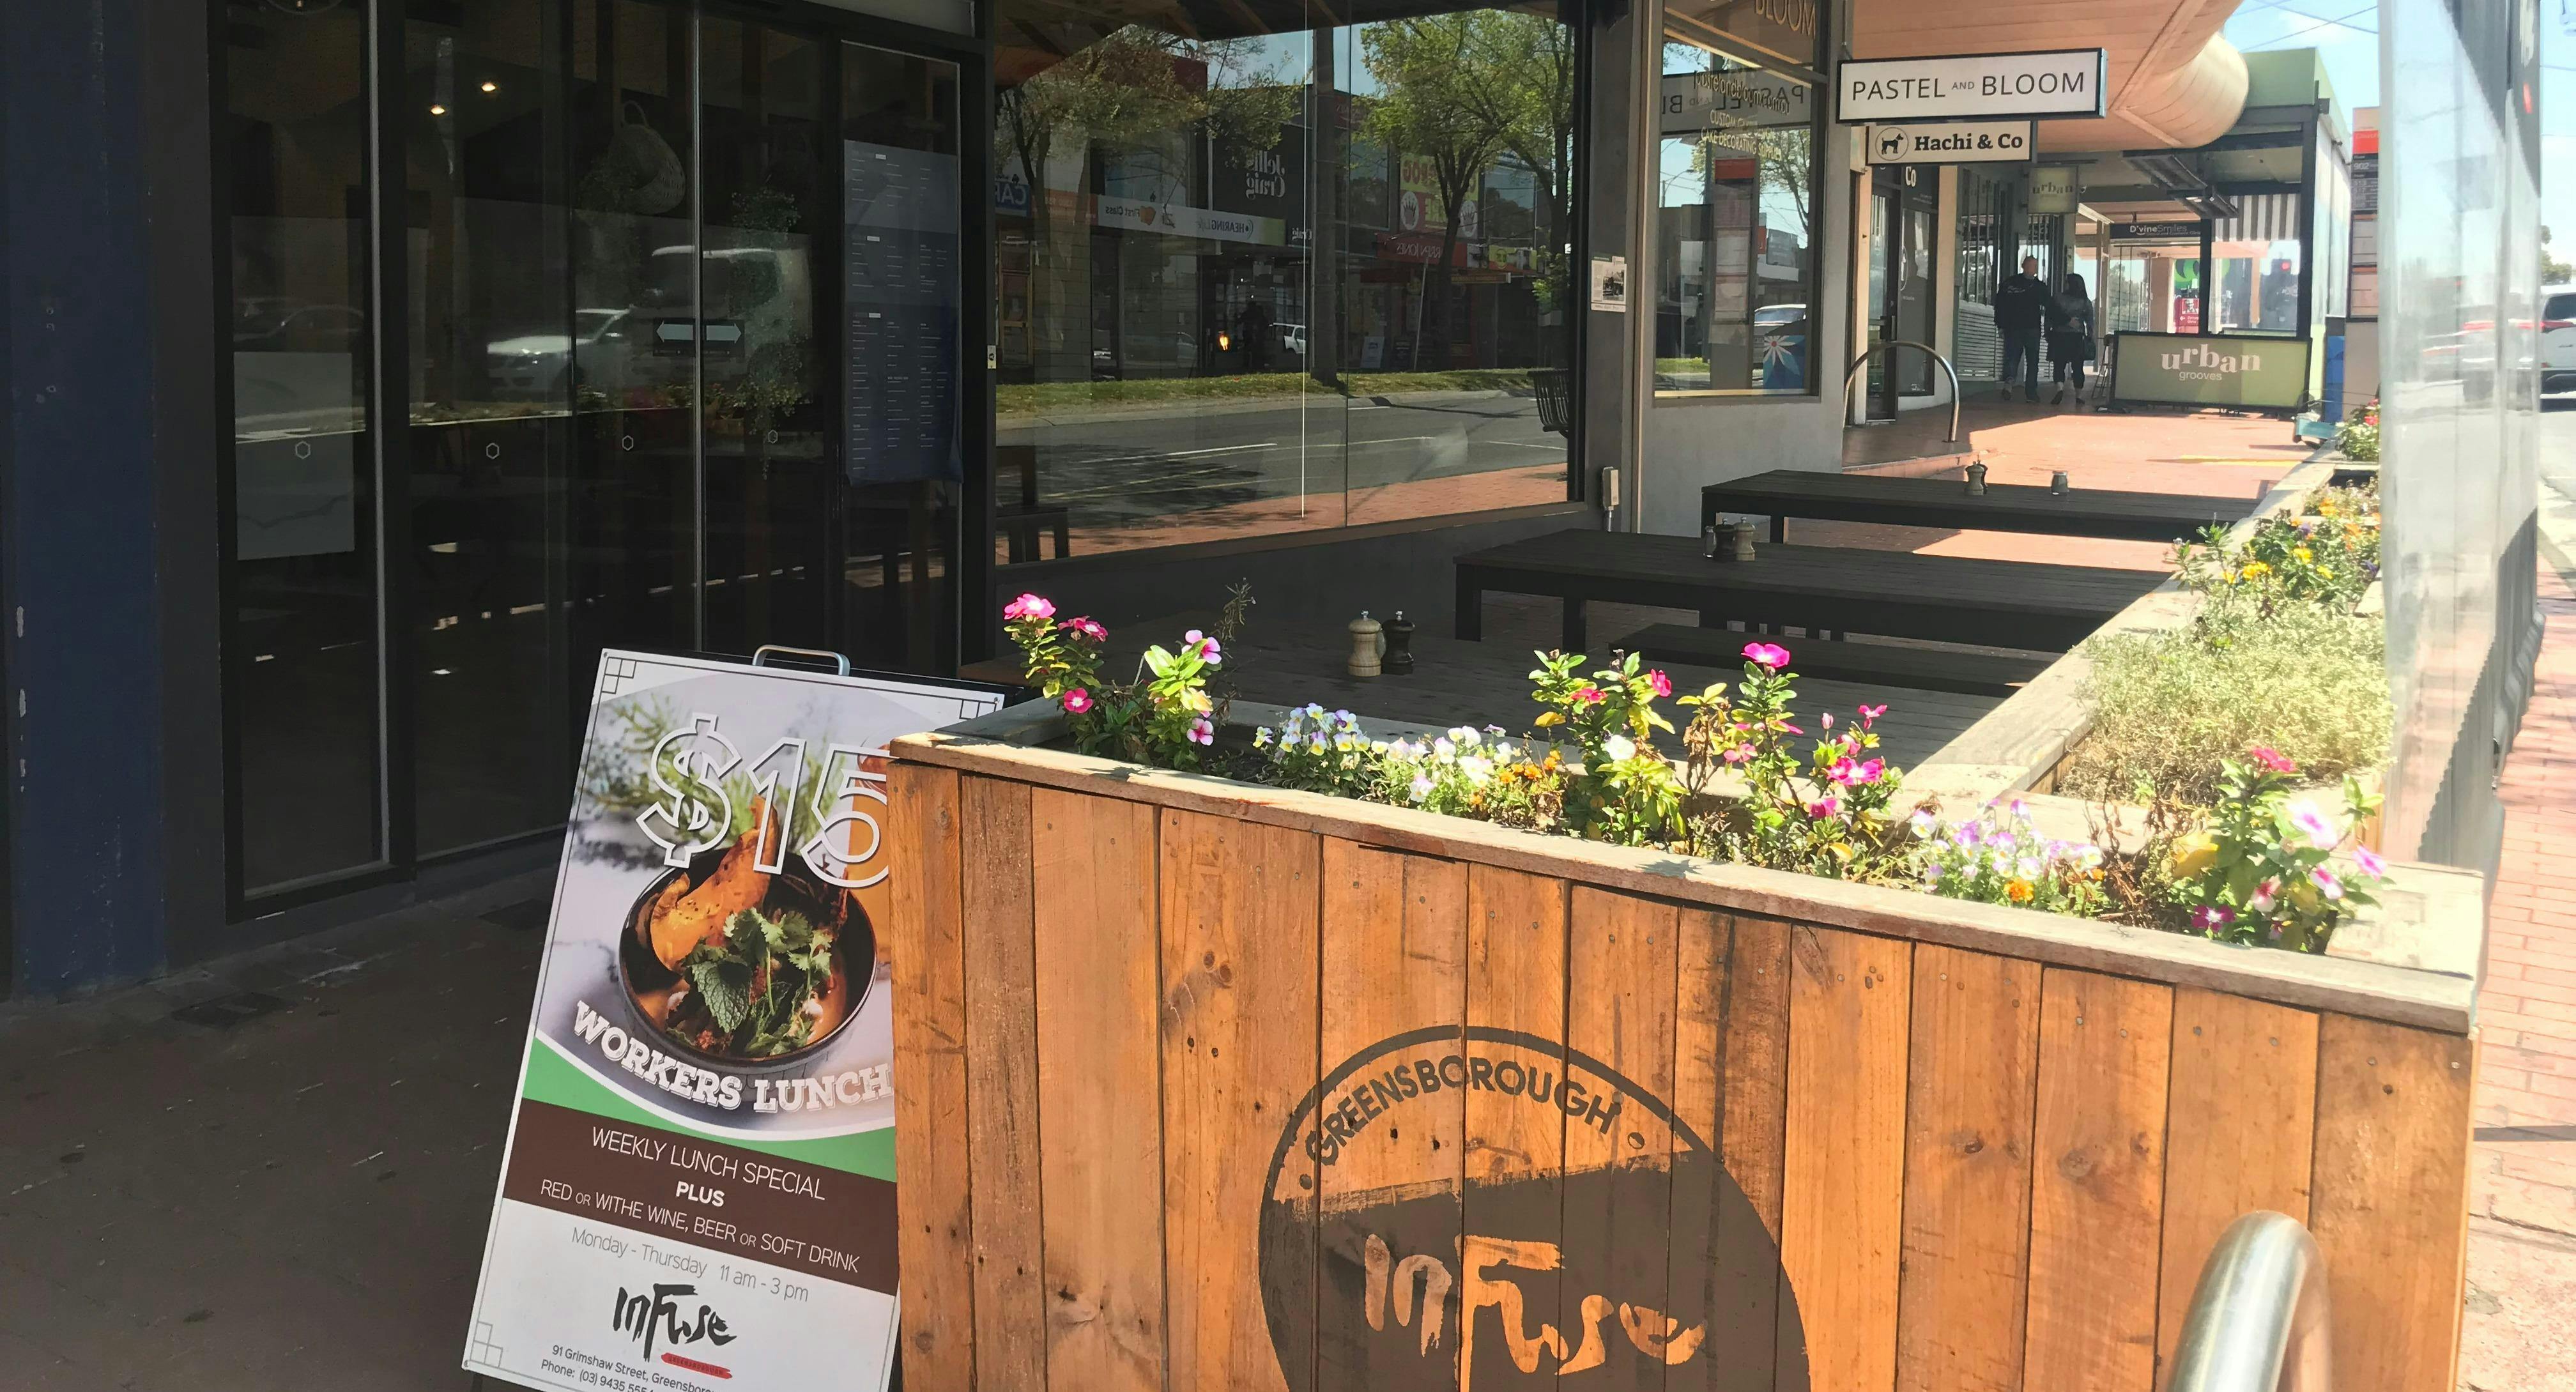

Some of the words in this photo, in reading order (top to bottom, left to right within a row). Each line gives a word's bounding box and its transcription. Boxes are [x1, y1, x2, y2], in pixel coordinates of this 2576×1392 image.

[1853, 78, 1945, 100] PASTEL
[1952, 81, 1974, 90] AND
[1982, 72, 2083, 96] BLOOM
[1914, 133, 1972, 151] Hachi
[1977, 135, 1993, 149] &
[1998, 134, 2023, 148] Co
[1905, 166, 1916, 187] Co
[2032, 182, 2073, 194] urban
[2161, 344, 2261, 373] urban
[2179, 371, 2222, 381] grooves
[636, 712, 899, 889] $15
[574, 1000, 743, 1110] WORKERS
[753, 1062, 893, 1113] LUNCH
[1305, 1055, 1621, 1166] GREENSBOROUGH
[592, 1126, 668, 1161] WEEKLY
[670, 1145, 738, 1179] LUNCH
[742, 1162, 825, 1200] SPECIAL
[675, 1181, 725, 1207] PLUS
[540, 1179, 572, 1201] RED
[575, 1192, 591, 1206] OR
[595, 1191, 644, 1219] WITHE
[648, 1205, 688, 1233] WINE,
[694, 1216, 737, 1243] BEER
[740, 1233, 756, 1247] OR
[760, 1234, 806, 1258] SOFT
[809, 1245, 860, 1273] DRINK
[572, 1227, 629, 1258] Monday
[642, 1244, 707, 1276] Thursday
[720, 1264, 730, 1281] 11
[733, 1271, 756, 1289] am
[770, 1278, 781, 1294] 3
[784, 1284, 809, 1302] pm
[541, 1359, 575, 1378] Phone:
[579, 1369, 598, 1386] (03)
[600, 1376, 625, 1391] 9435
[628, 1383, 654, 1392] 555
[553, 1345, 564, 1356] 91
[565, 1348, 613, 1371] Grimshaw
[615, 1362, 648, 1382] Street,
[652, 1373, 715, 1392] Greensbor
